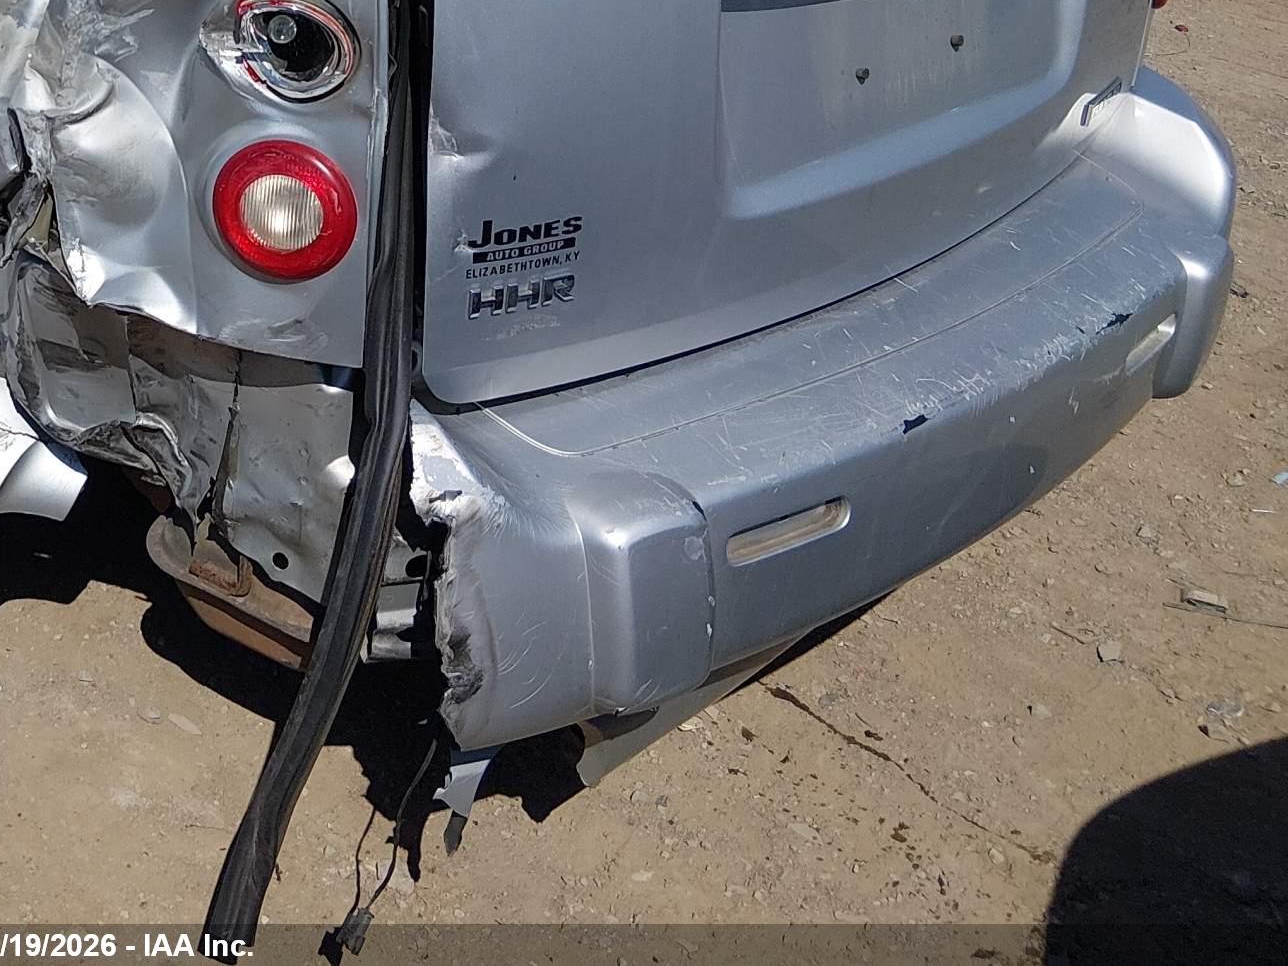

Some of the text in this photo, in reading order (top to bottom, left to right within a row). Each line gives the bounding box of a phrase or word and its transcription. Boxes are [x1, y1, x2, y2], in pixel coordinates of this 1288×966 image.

[465, 250, 581, 280] ELIZABETHTOWN, KY
[486, 240, 565, 262] AUTO GROUP
[468, 274, 576, 320] HHR
